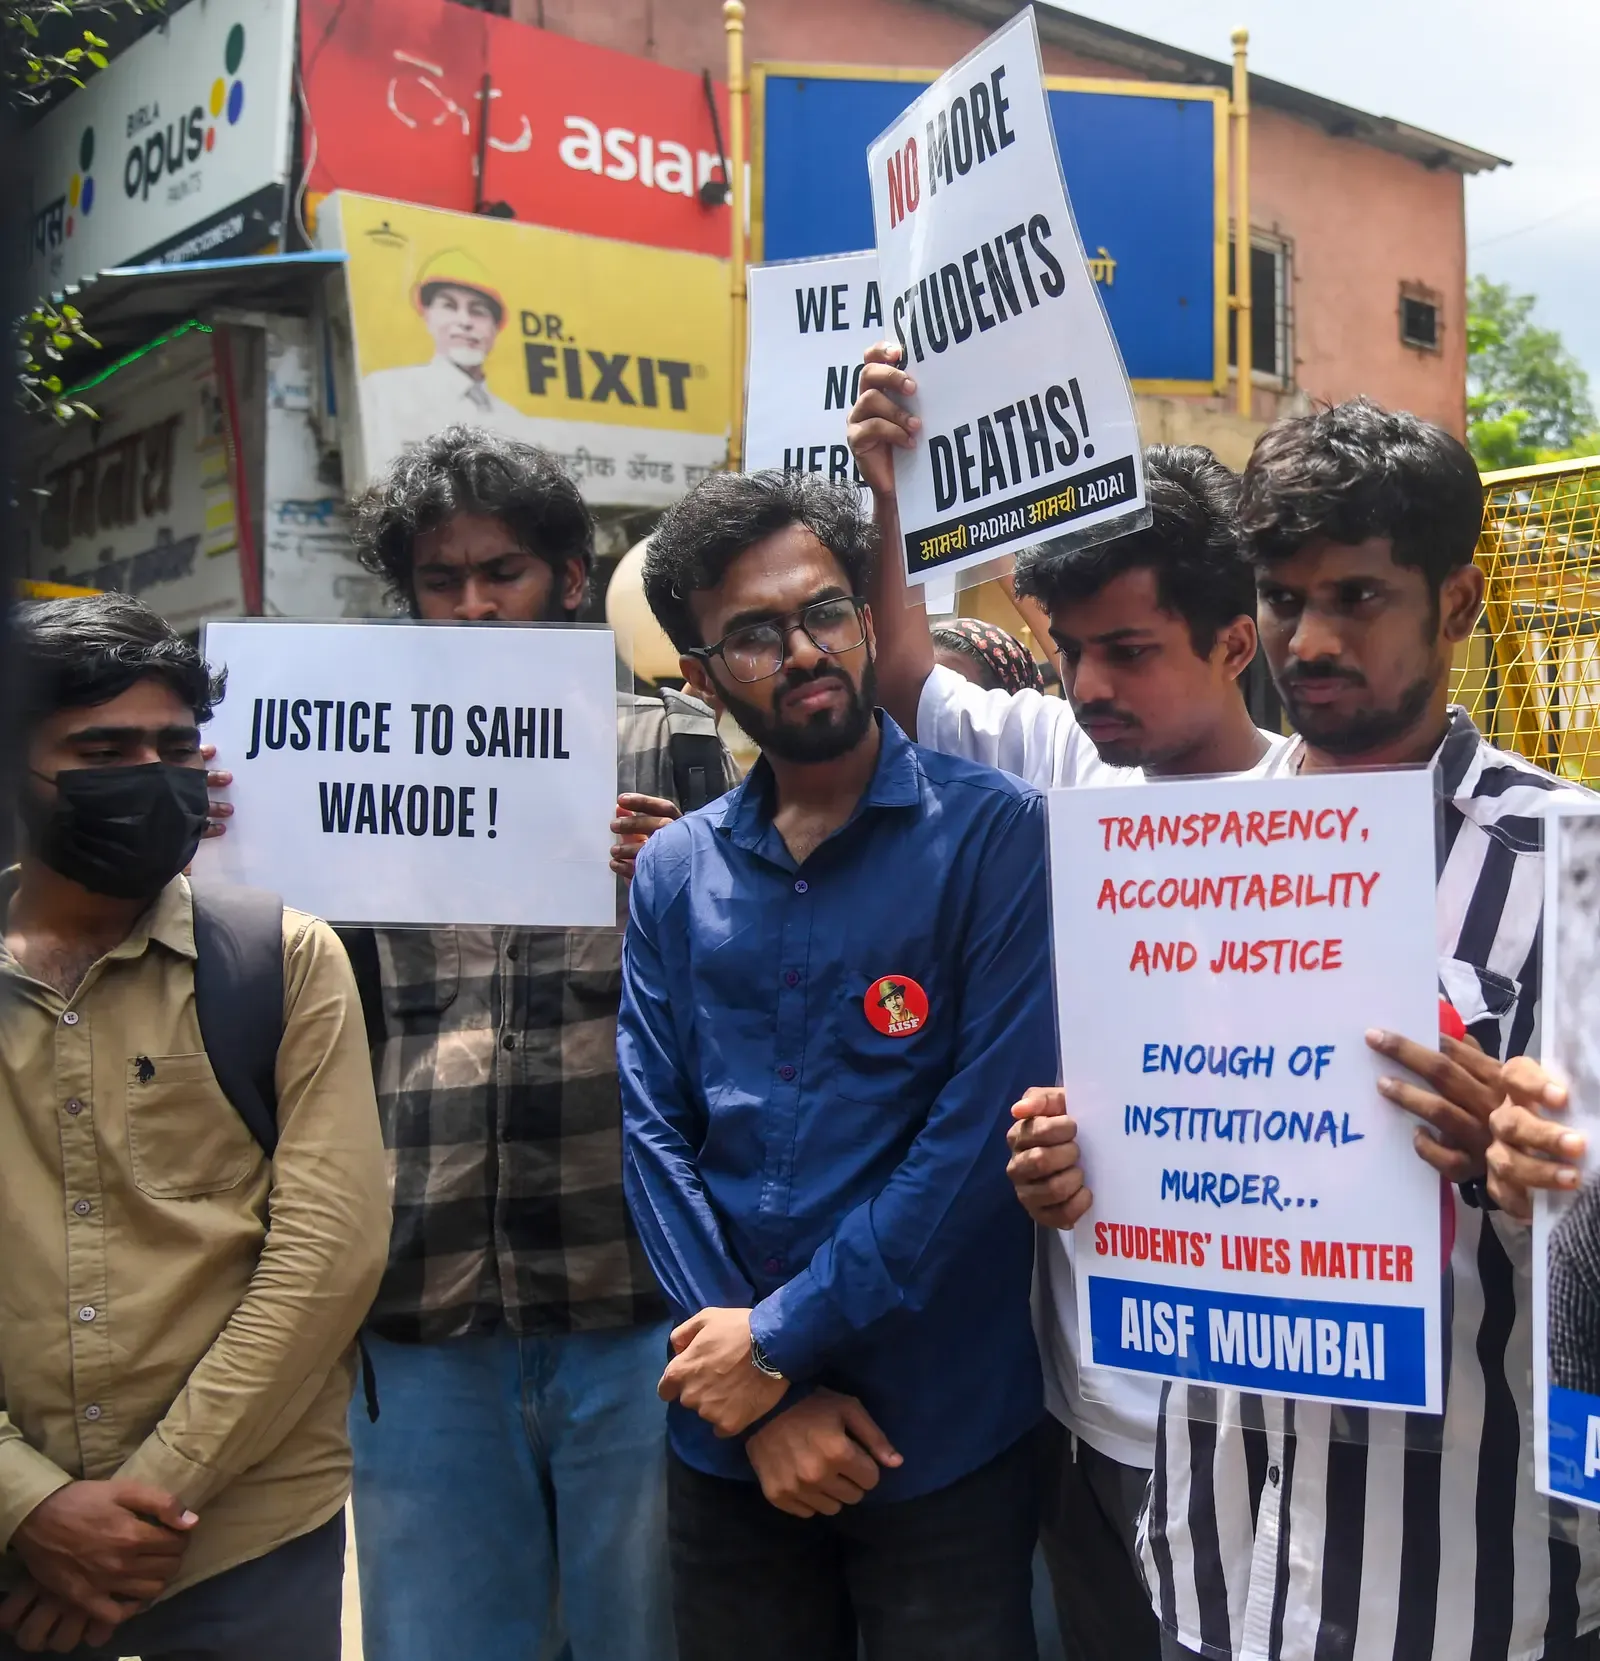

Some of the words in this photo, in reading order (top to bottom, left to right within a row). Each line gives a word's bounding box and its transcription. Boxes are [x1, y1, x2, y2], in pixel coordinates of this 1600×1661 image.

[124, 105, 204, 201] opus
[887, 137, 920, 229] NO
[926, 64, 1016, 196] MORE
[796, 284, 849, 333] WE
[893, 213, 1066, 371] STUDENTS
[520, 309, 576, 343] DR.
[523, 342, 693, 412] FIXIT
[929, 377, 1095, 512] DEATHS!
[919, 524, 967, 562] आमची
[968, 508, 1025, 546] PADHAI
[1027, 486, 1076, 525] आमची
[1077, 473, 1125, 508] LADAI
[246, 698, 392, 760] JUSTICE
[411, 703, 453, 756] TO
[465, 705, 570, 760] SAHIL
[319, 782, 475, 838] WAKODE
[1098, 807, 1369, 852] TRANSPARENCY,
[1097, 871, 1380, 915] ACCOUNTABILITY
[1129, 940, 1198, 976] AND
[1210, 938, 1343, 974] JUSTICE
[888, 1018, 920, 1034] AISF
[1142, 1043, 1274, 1079] ENOUGH
[1288, 1045, 1335, 1080] OF
[1124, 1104, 1365, 1148] INSTITUTIONAL
[1160, 1168, 1319, 1211] MURDER...
[1221, 1234, 1291, 1275] LIVES
[1300, 1239, 1414, 1282] MATTER
[1120, 1296, 1195, 1358] AISF
[1208, 1307, 1385, 1380] MUMBAI
